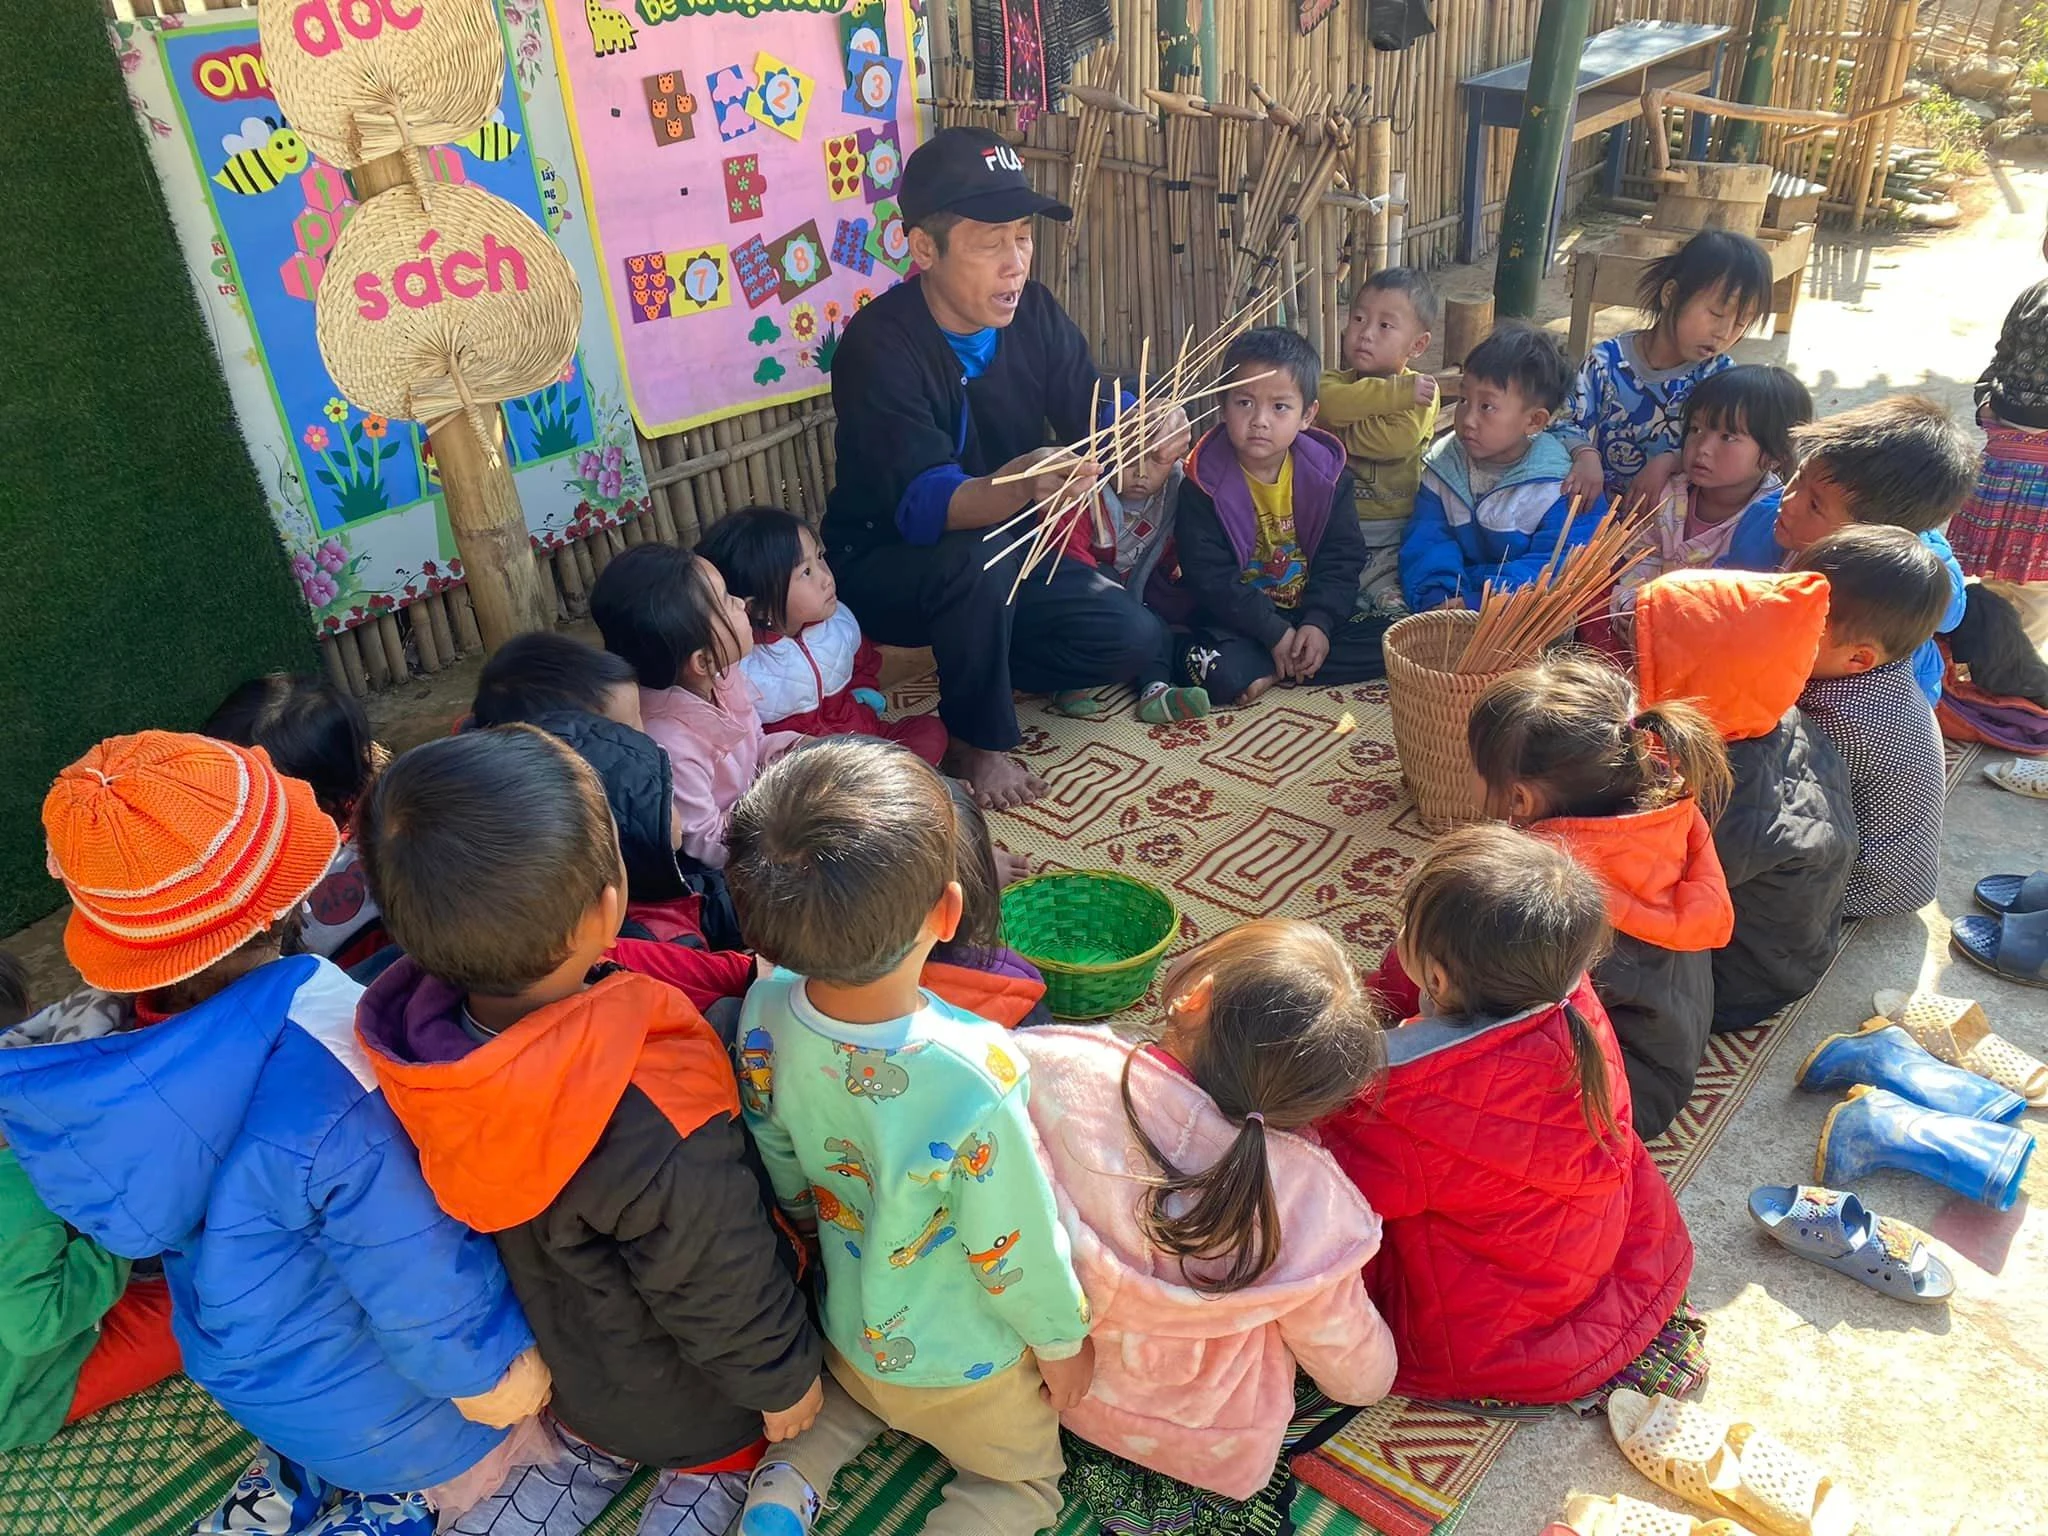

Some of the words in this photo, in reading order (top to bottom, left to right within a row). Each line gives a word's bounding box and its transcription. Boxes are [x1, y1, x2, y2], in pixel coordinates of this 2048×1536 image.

[200, 53, 270, 97] on
[871, 74, 885, 100] 3
[772, 81, 791, 110] 2
[981, 145, 1025, 171] FILA
[298, 214, 330, 257] p
[891, 227, 905, 251] 9
[793, 246, 809, 273] 8
[354, 228, 529, 321] sách
[693, 268, 708, 296] 7
